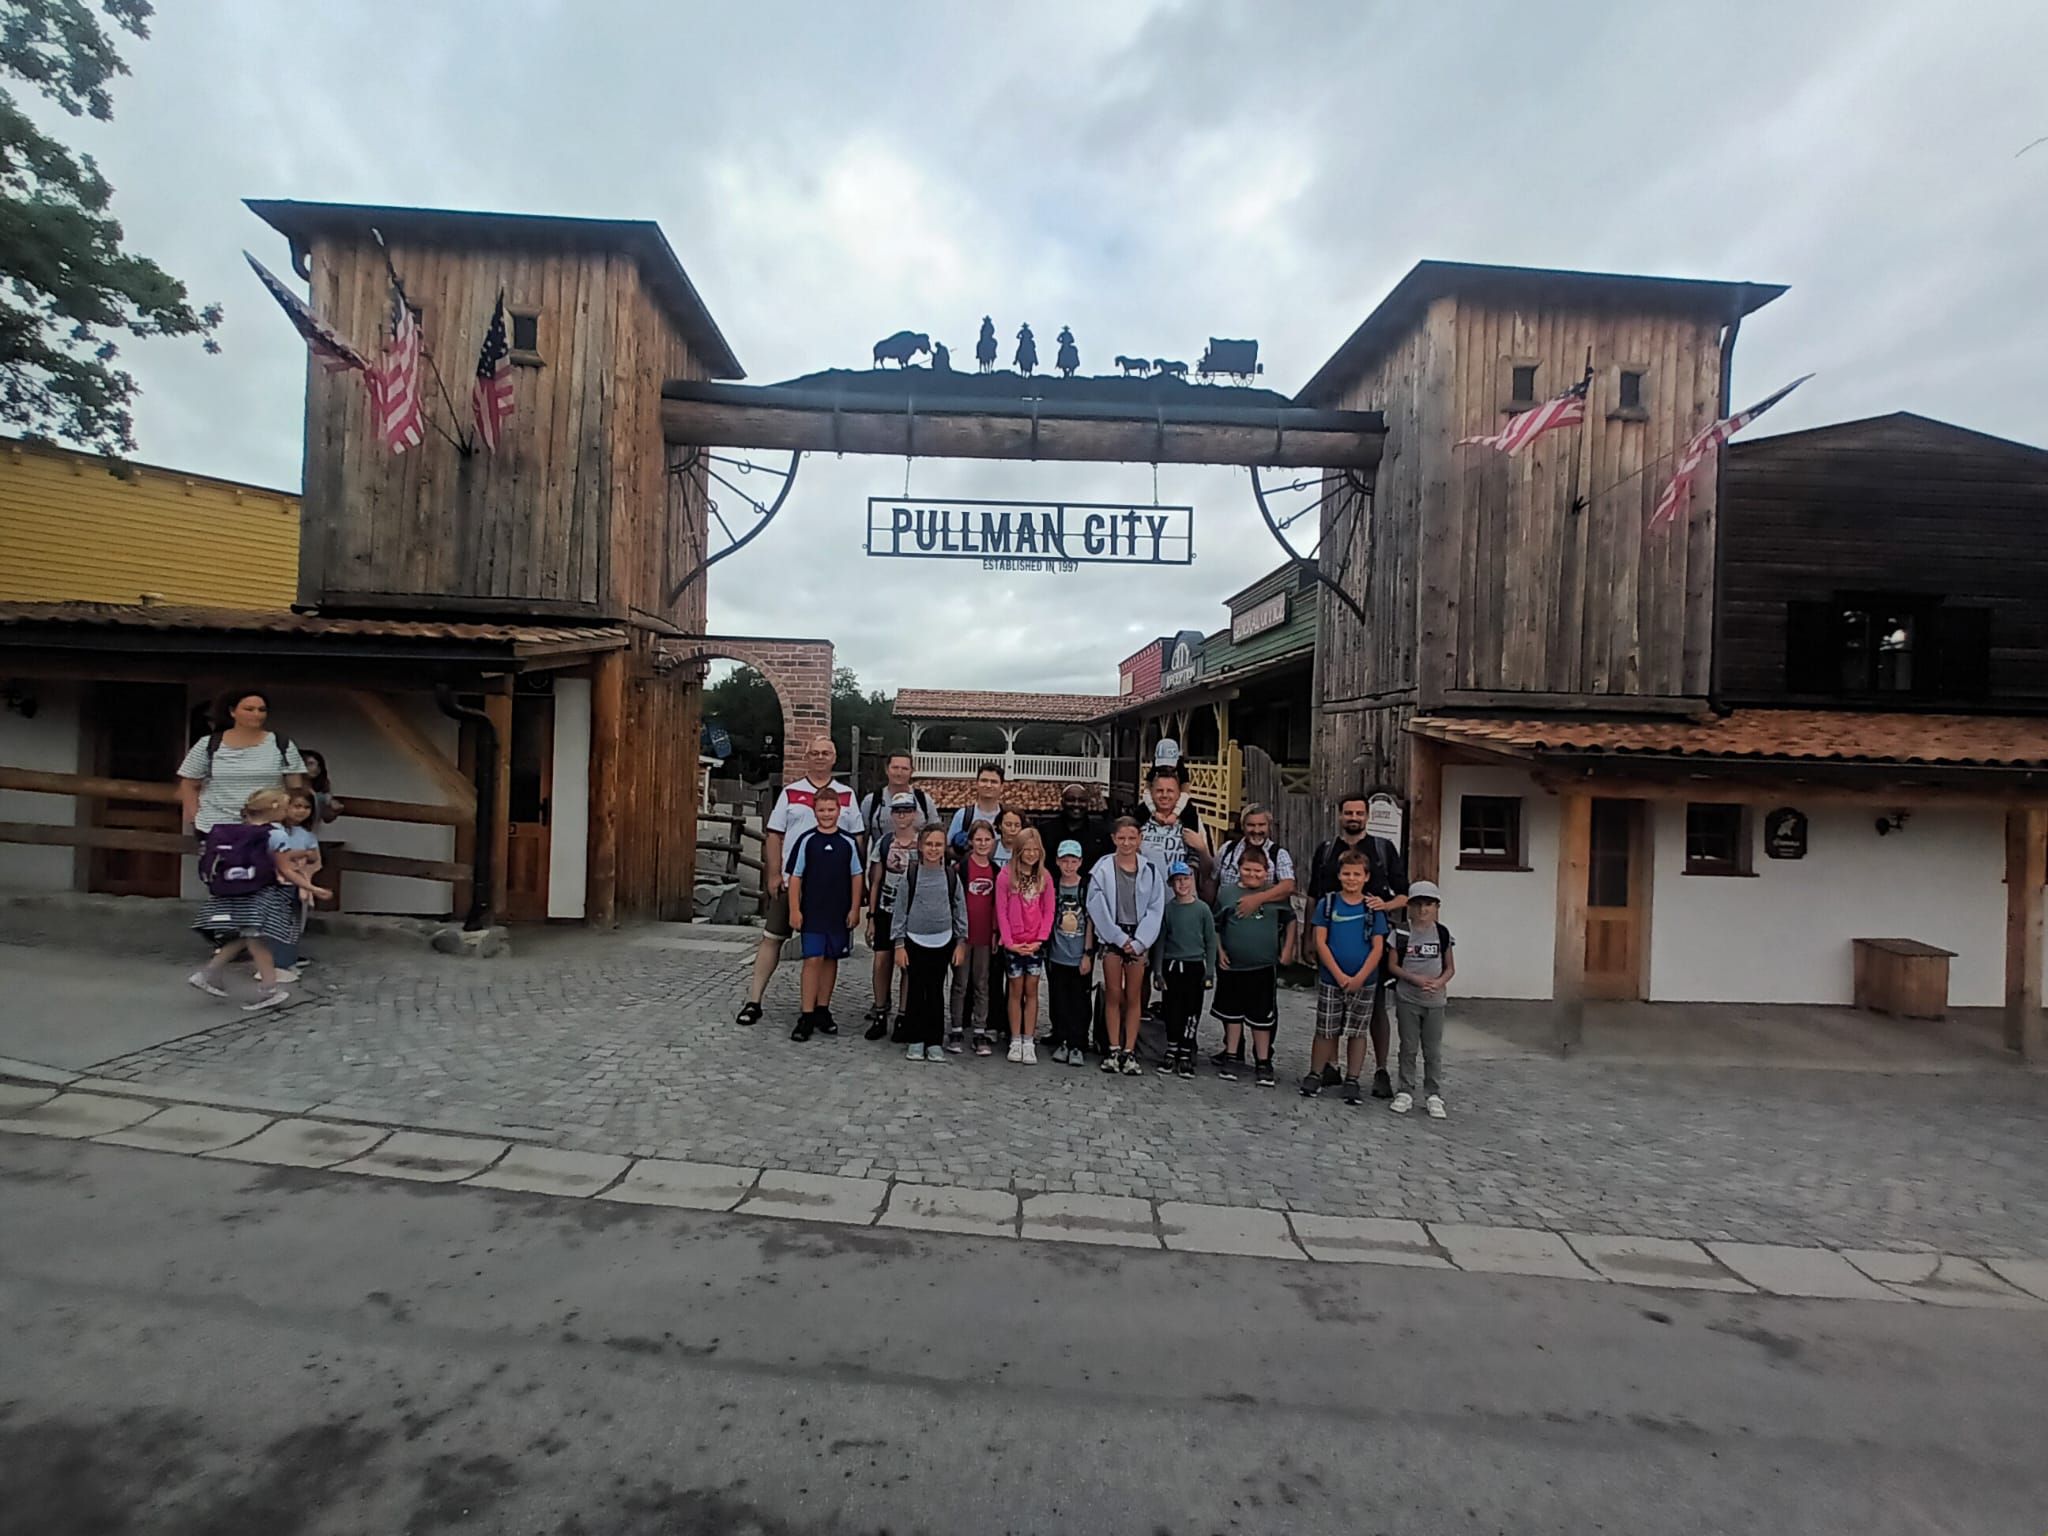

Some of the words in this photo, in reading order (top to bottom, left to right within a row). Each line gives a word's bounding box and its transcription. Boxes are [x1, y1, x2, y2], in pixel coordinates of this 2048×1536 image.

[891, 506, 1070, 556] PULLMAN
[1084, 508, 1169, 561] CITY
[983, 559, 1042, 571] ESTABLISHED
[1045, 561, 1056, 574] IN
[1058, 561, 1079, 573] 1997
